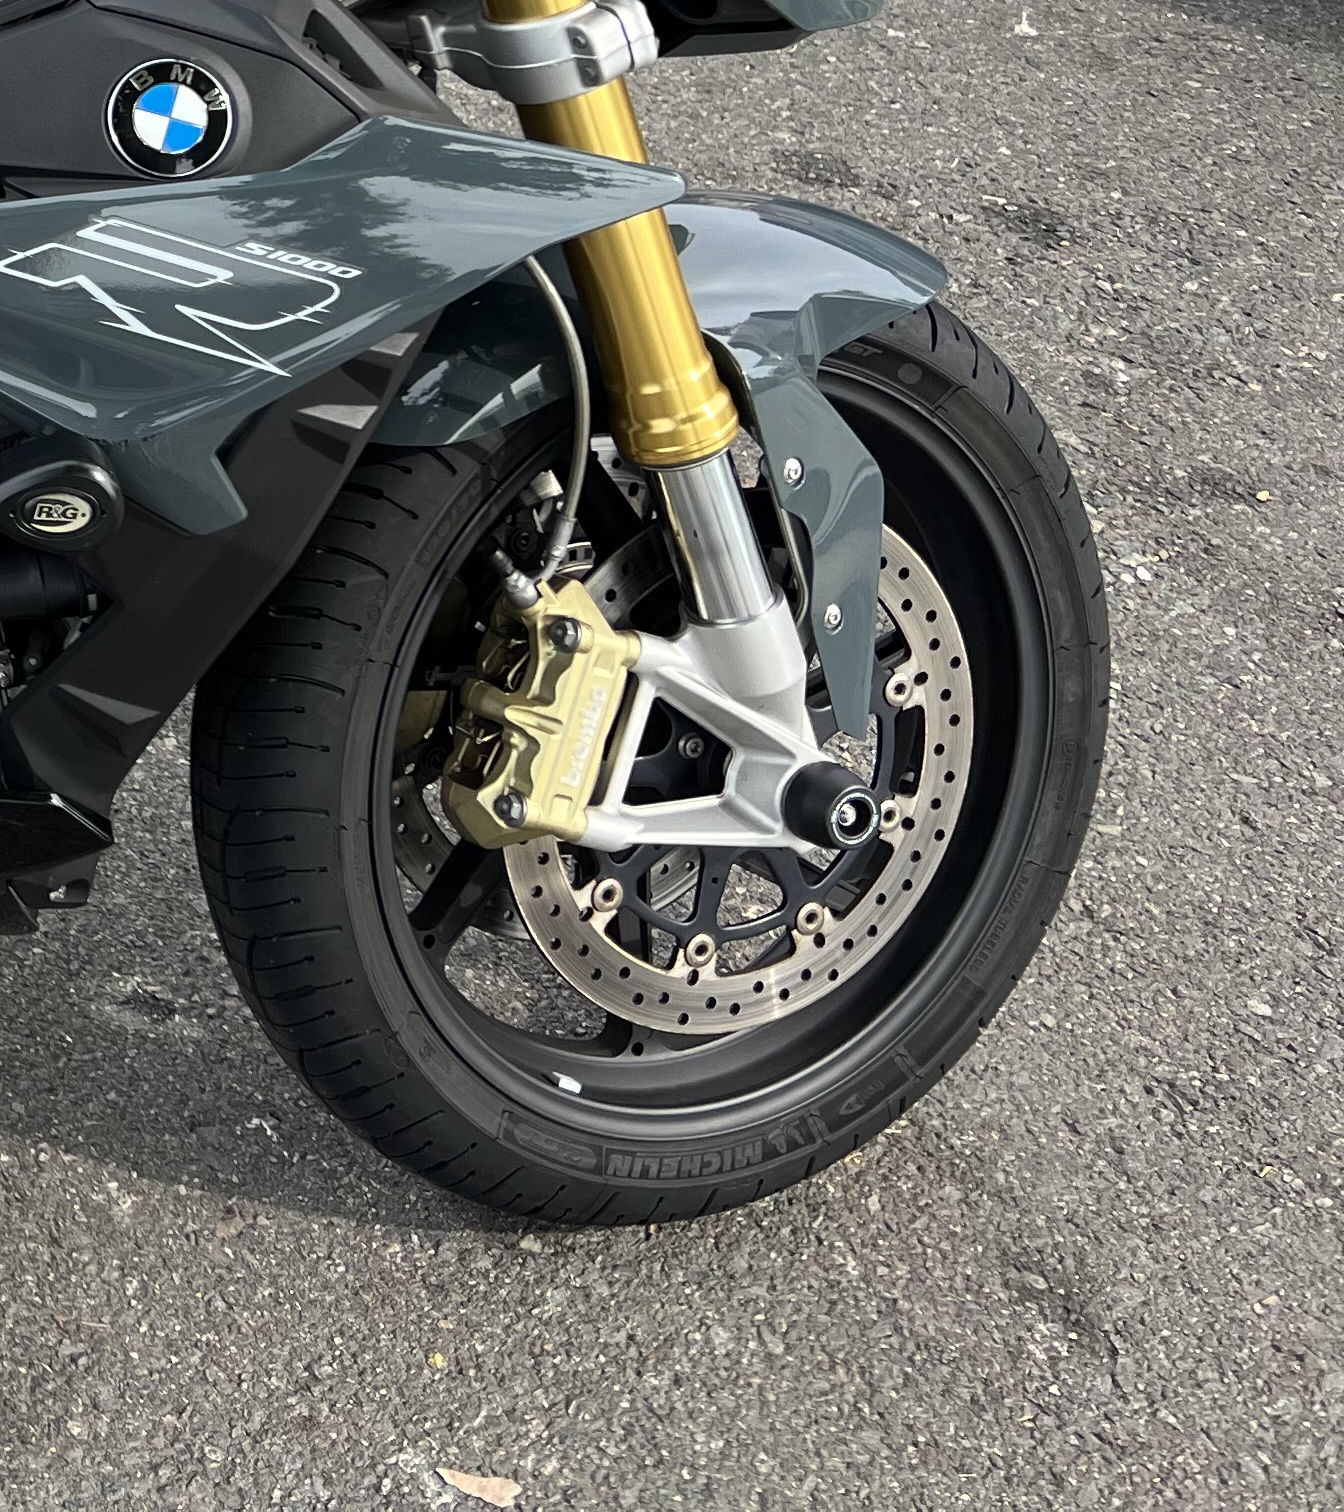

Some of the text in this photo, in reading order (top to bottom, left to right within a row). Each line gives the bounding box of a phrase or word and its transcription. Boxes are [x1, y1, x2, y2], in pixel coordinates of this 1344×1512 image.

[129, 64, 228, 112] BMW
[234, 242, 363, 279] S1000
[35, 502, 80, 521] R&G
[559, 685, 607, 788] brembo
[606, 1136, 764, 1180] MICHELIN
